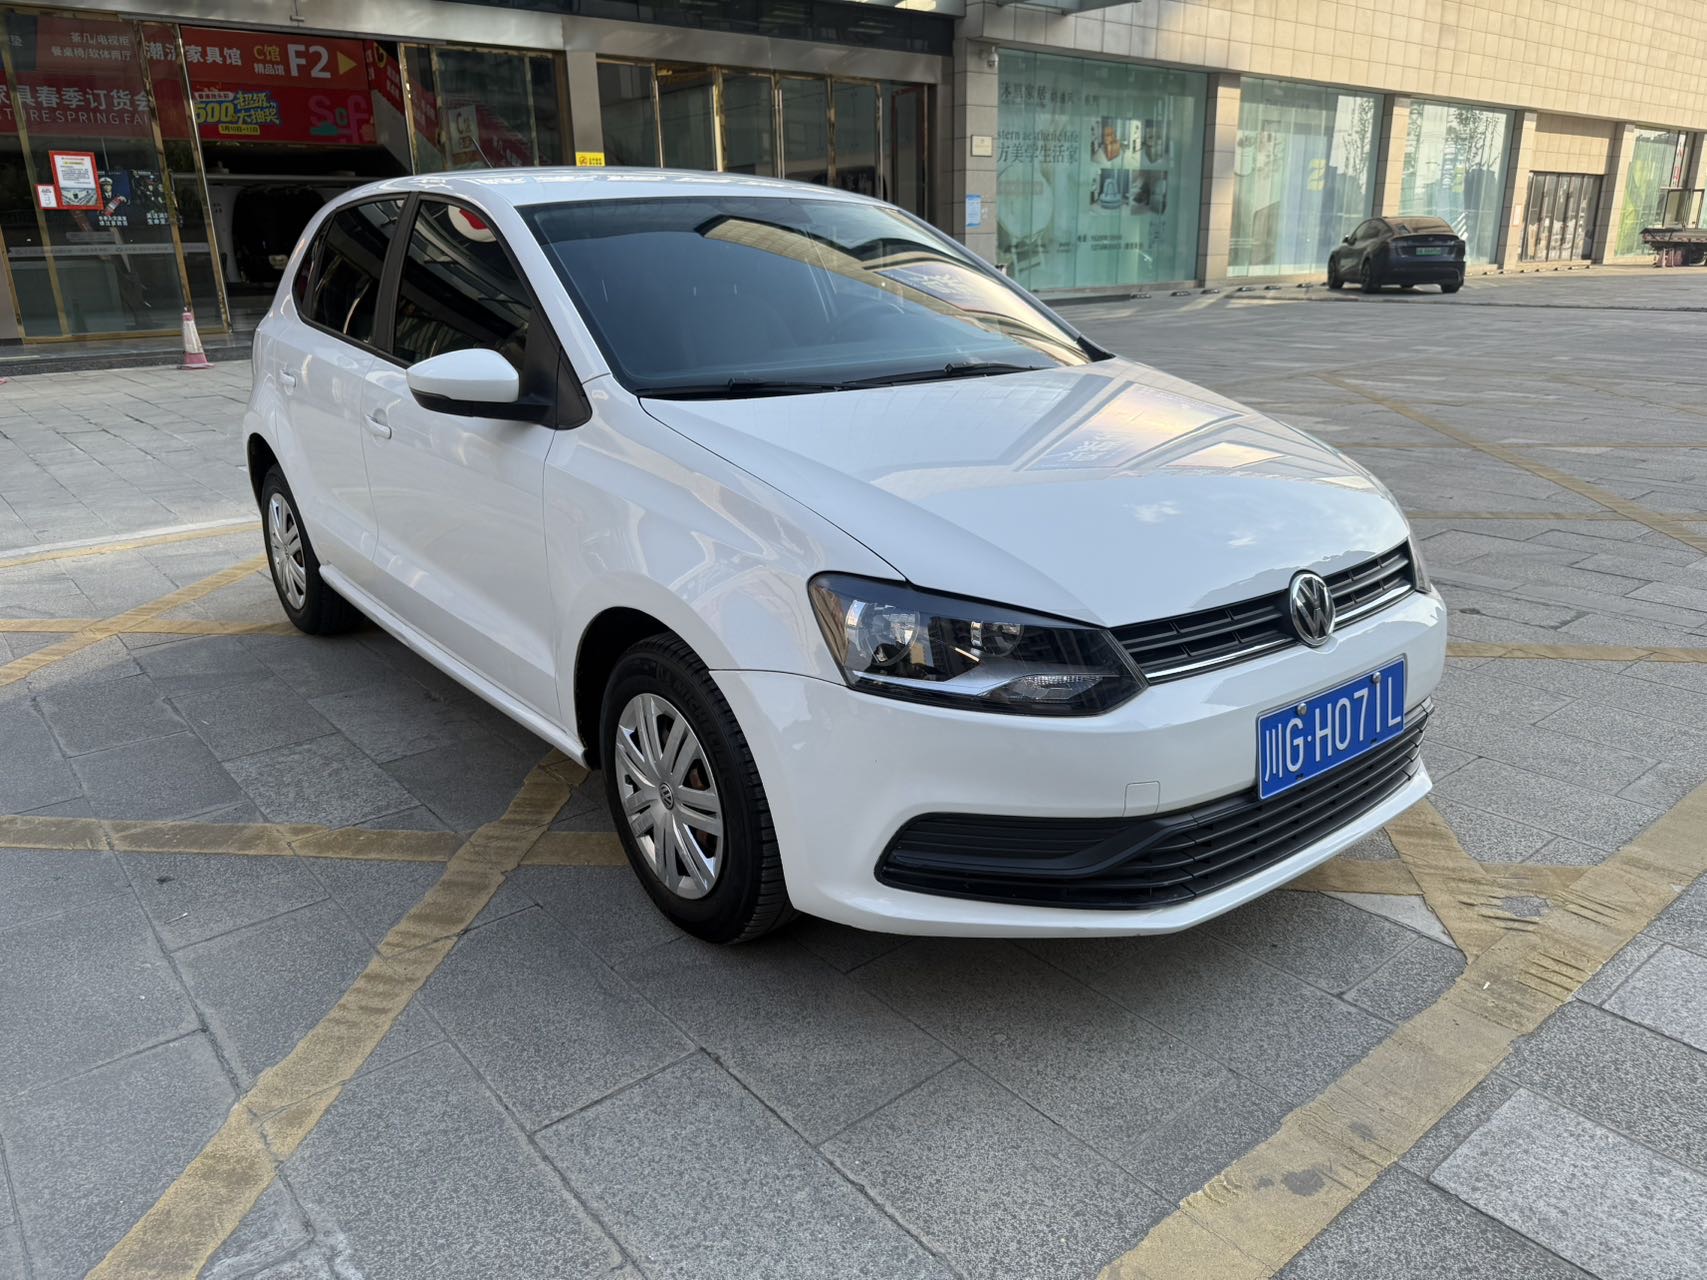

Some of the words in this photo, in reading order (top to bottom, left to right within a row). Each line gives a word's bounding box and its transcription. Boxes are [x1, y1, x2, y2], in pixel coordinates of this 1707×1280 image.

[254, 46, 281, 62] C馆
[287, 43, 332, 79] F2
[56, 110, 119, 124] SPRING
[1264, 676, 1402, 782] 川G·H071L
